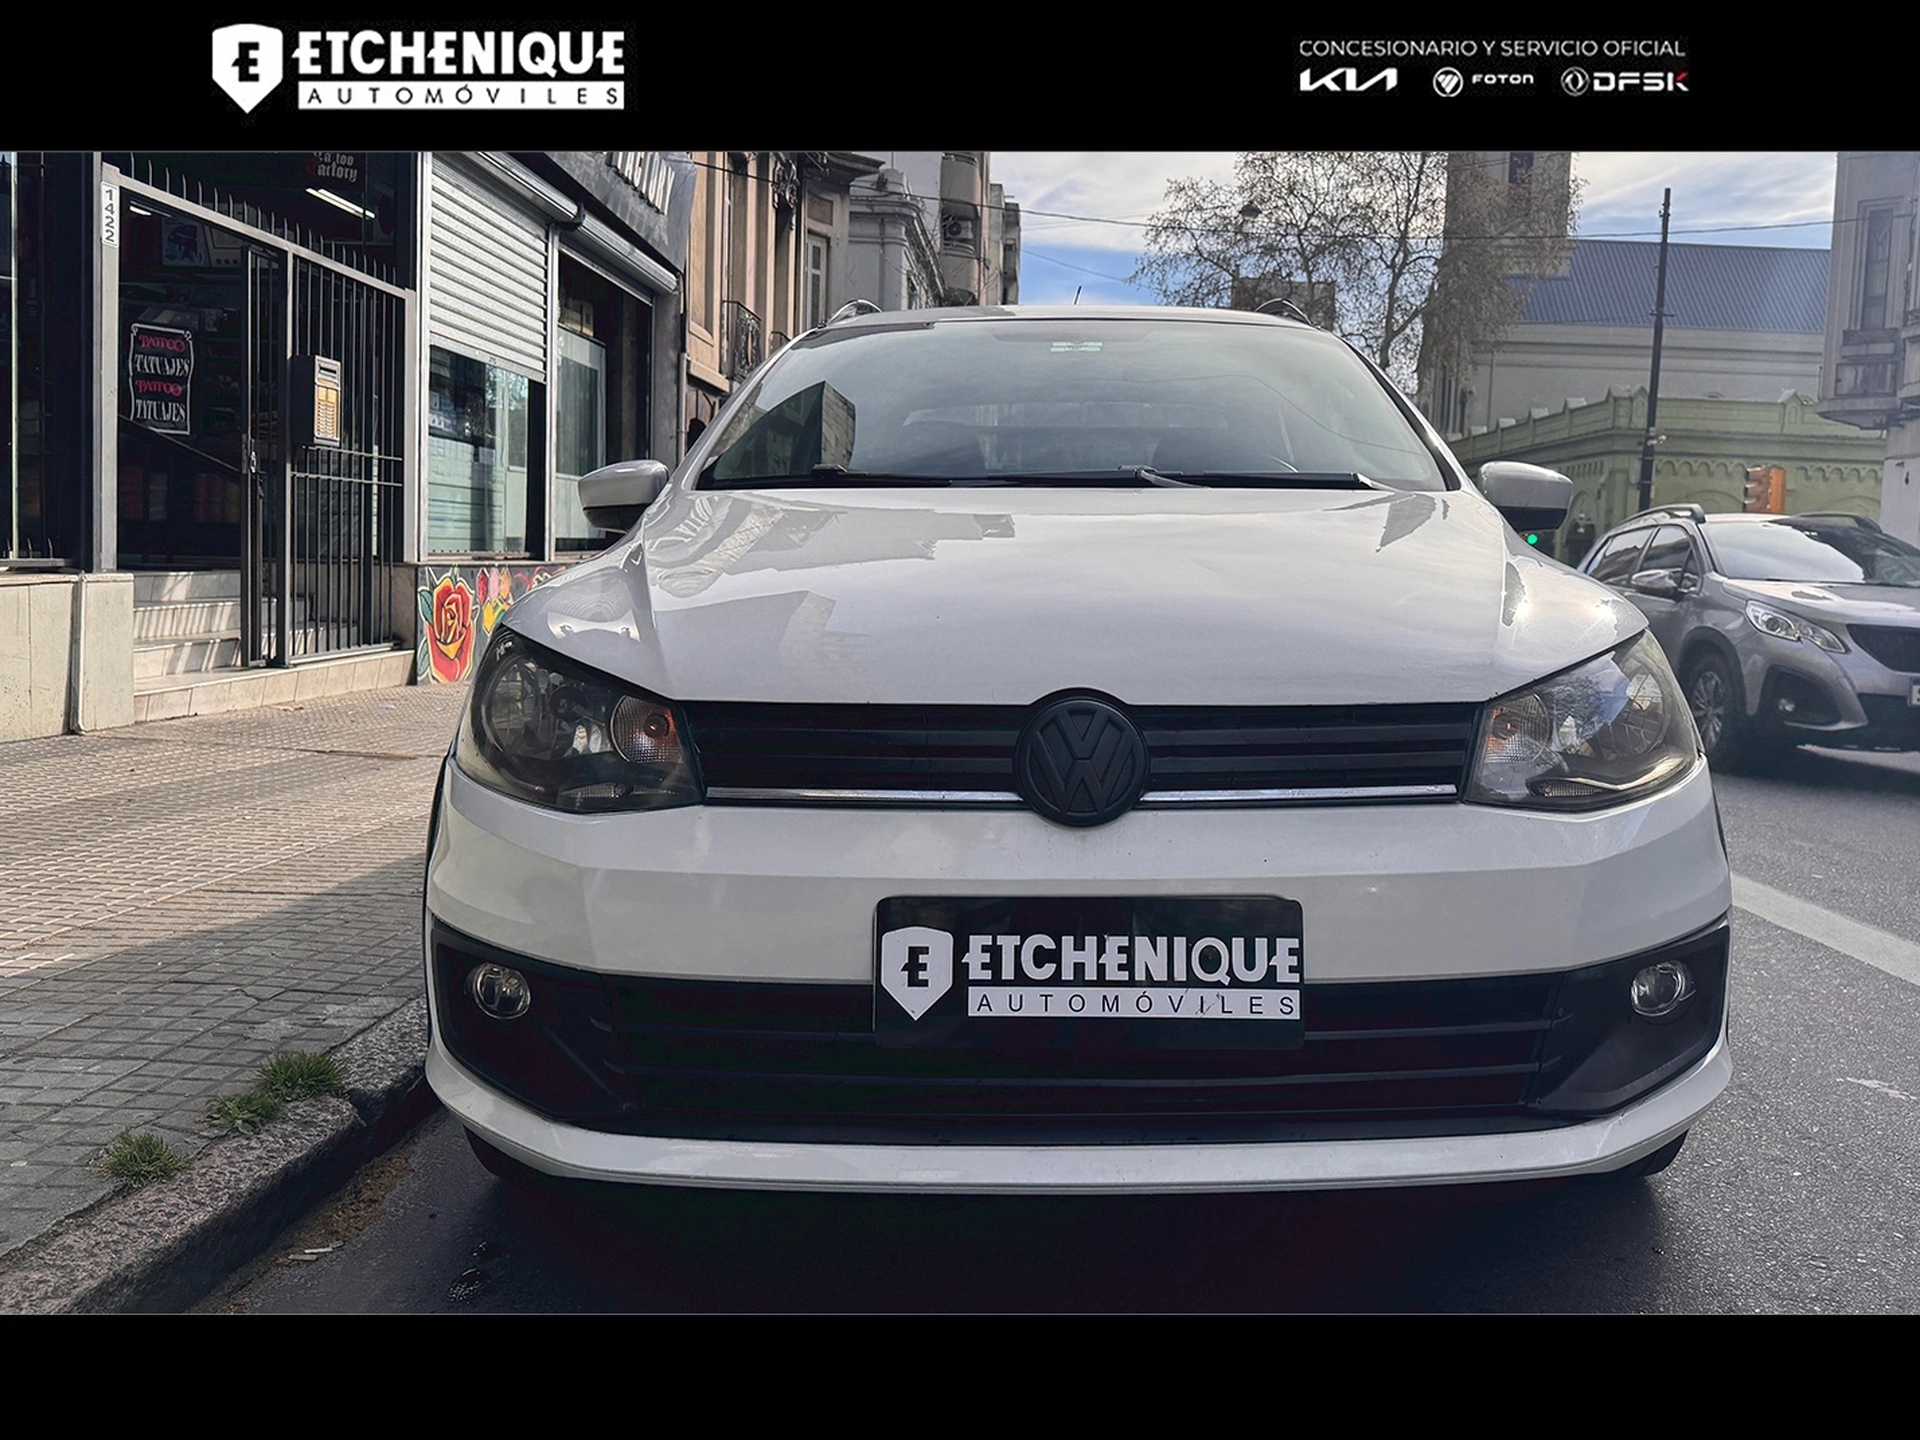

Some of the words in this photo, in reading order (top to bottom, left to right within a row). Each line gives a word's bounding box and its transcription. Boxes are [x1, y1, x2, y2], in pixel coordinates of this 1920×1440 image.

[104, 189, 115, 243] 1422
[961, 933, 1300, 986] ETCHENIQUE
[976, 989, 1297, 1016] AUTOMÓVILES
